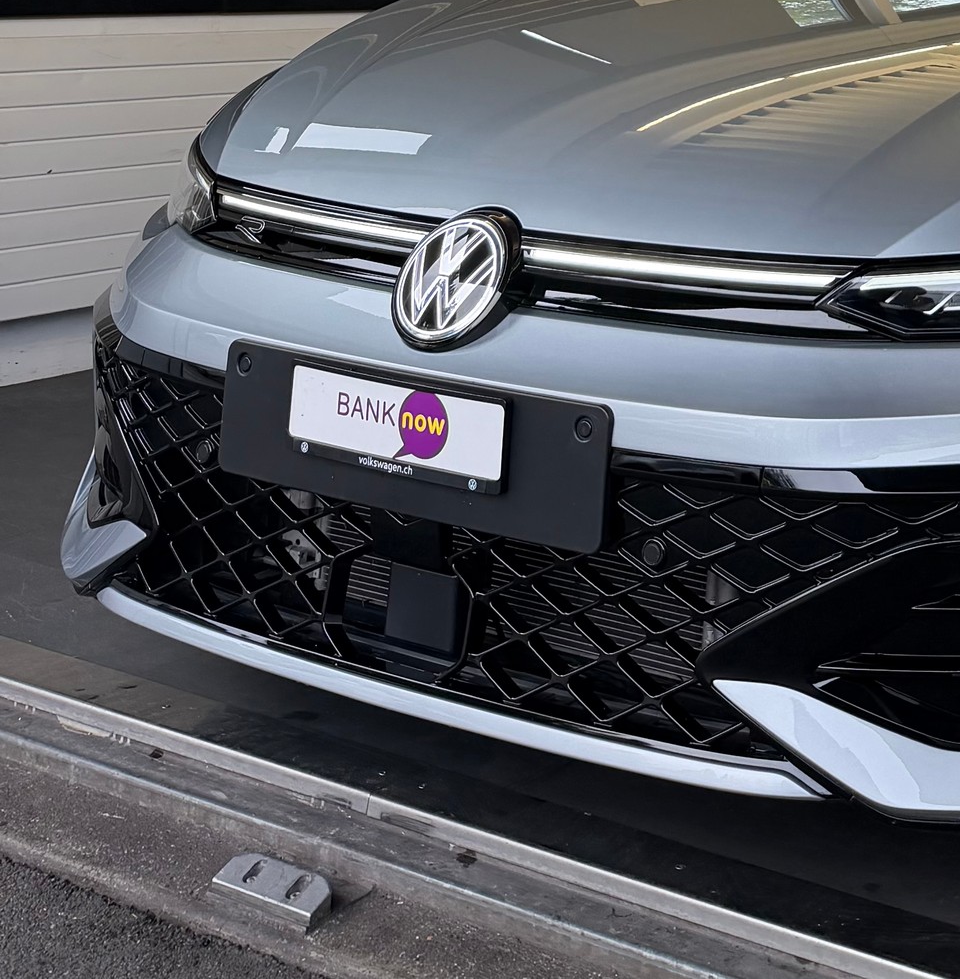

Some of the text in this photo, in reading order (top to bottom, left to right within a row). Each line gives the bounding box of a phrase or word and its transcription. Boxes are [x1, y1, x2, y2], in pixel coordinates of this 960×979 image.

[336, 391, 446, 436] BANK now
[358, 455, 413, 476] volkswagen.ch
